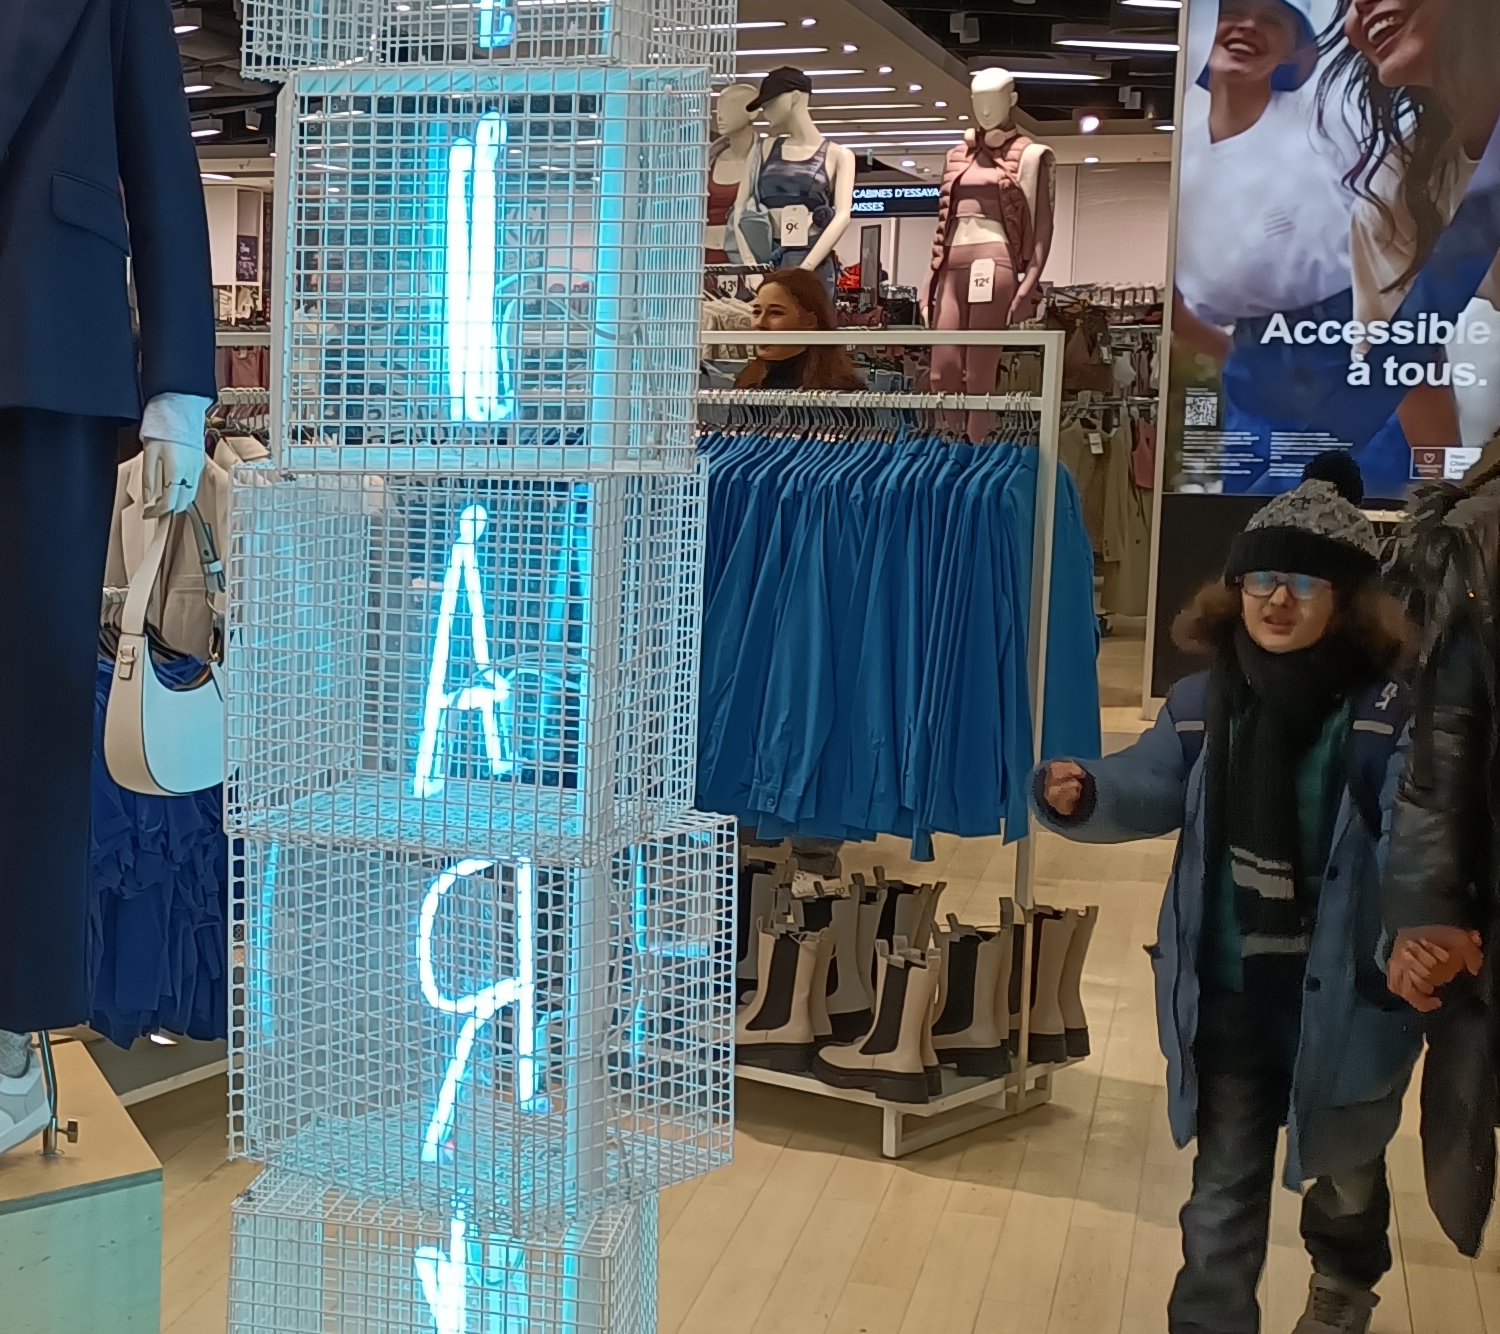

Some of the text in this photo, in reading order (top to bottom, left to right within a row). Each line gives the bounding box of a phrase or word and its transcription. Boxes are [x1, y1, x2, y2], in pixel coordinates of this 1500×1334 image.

[853, 188, 941, 198] CABINES D'ESSAYA
[851, 202, 884, 211] AISSES
[786, 223, 799, 234] 9€
[974, 277, 990, 287] 12€
[1260, 312, 1491, 345] Accessible
[1347, 353, 1488, 387] à tous.
